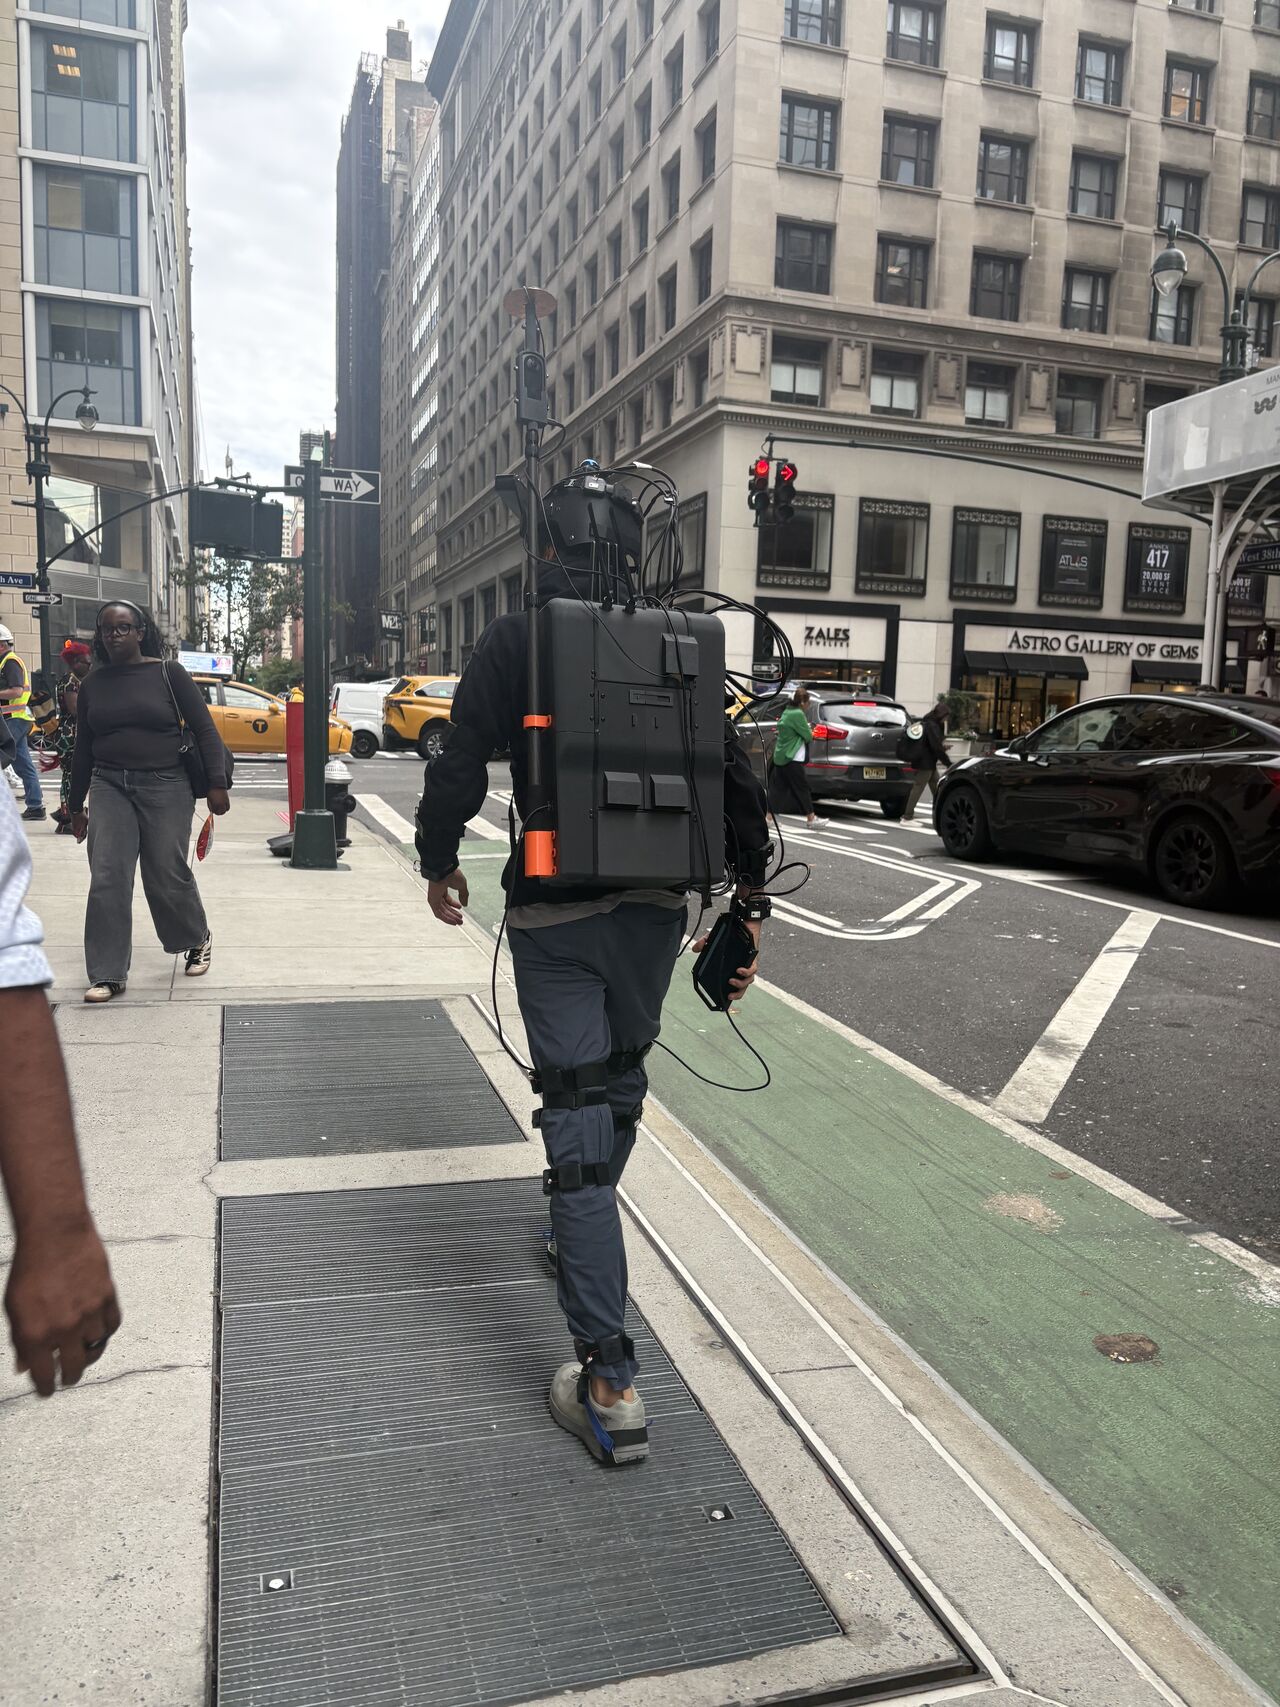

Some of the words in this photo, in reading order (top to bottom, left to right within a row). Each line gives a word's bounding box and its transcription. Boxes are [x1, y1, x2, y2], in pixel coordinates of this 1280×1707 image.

[333, 478, 361, 492] WAY
[1146, 549, 1170, 568] 417
[7, 576, 24, 584] Ave
[1142, 570, 1163, 581] 20,000
[1163, 572, 1171, 581] SF
[1141, 586, 1170, 595] SPACE
[804, 626, 850, 641] ZALES
[1008, 630, 1062, 651] ASTRO
[1065, 634, 1133, 657] GALLERY
[1136, 642, 1156, 657] OF
[1160, 644, 1200, 660] GEMS
[255, 721, 266, 732] T
